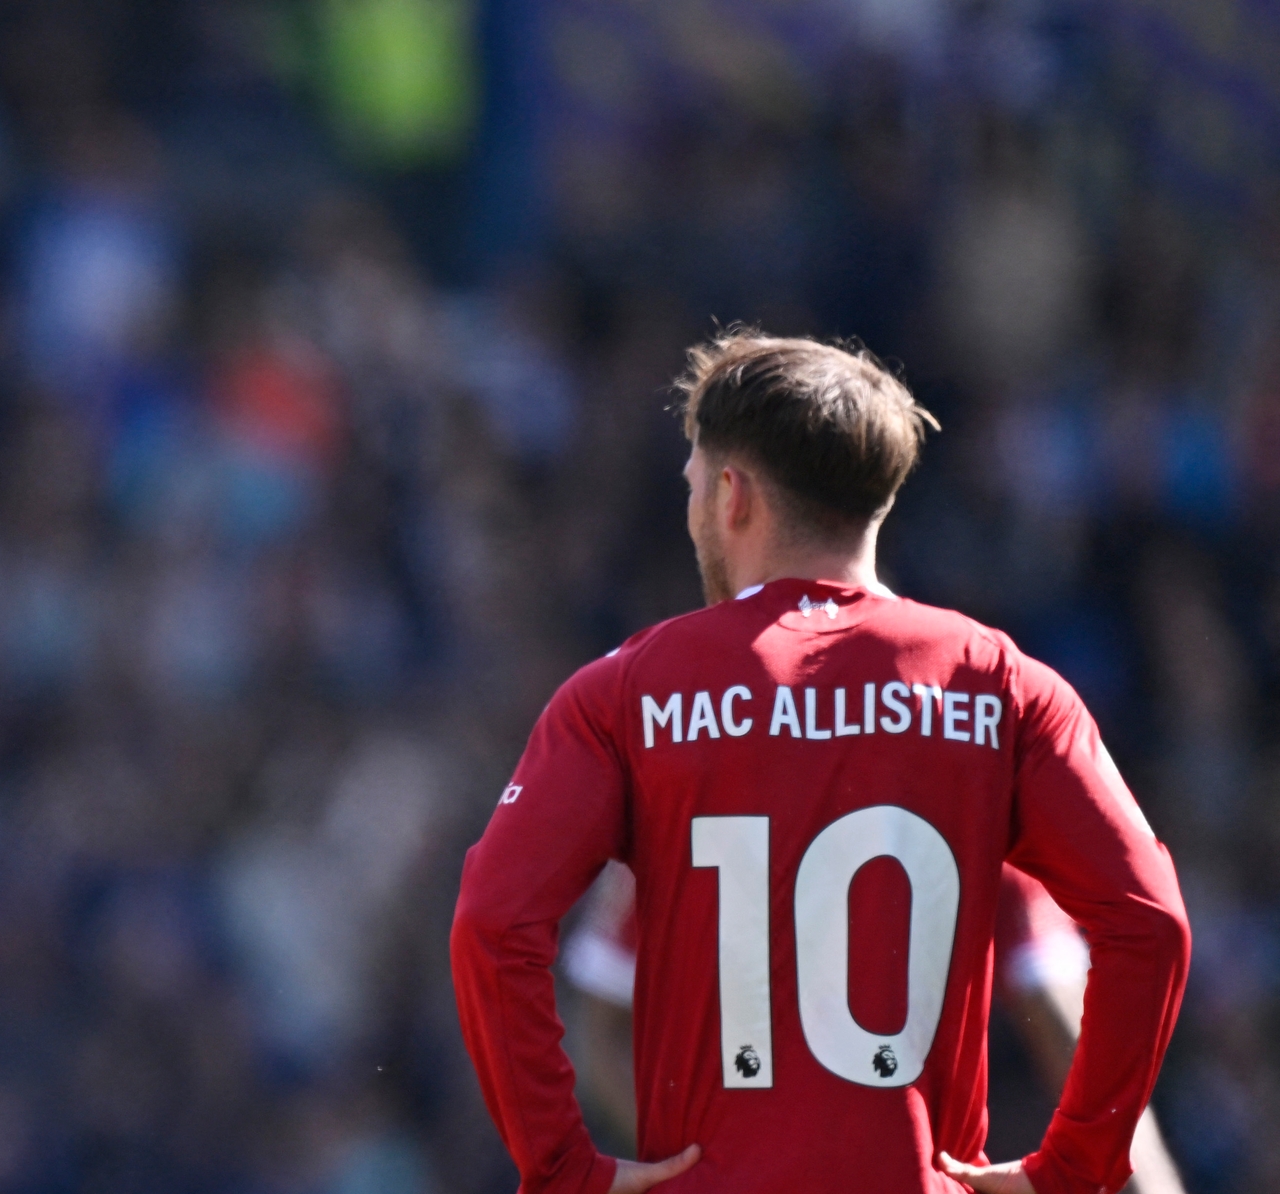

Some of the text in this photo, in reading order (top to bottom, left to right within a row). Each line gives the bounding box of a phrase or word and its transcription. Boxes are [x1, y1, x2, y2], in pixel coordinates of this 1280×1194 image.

[641, 681, 1003, 750] MAC ALLISTER
[691, 804, 961, 1089] 10
